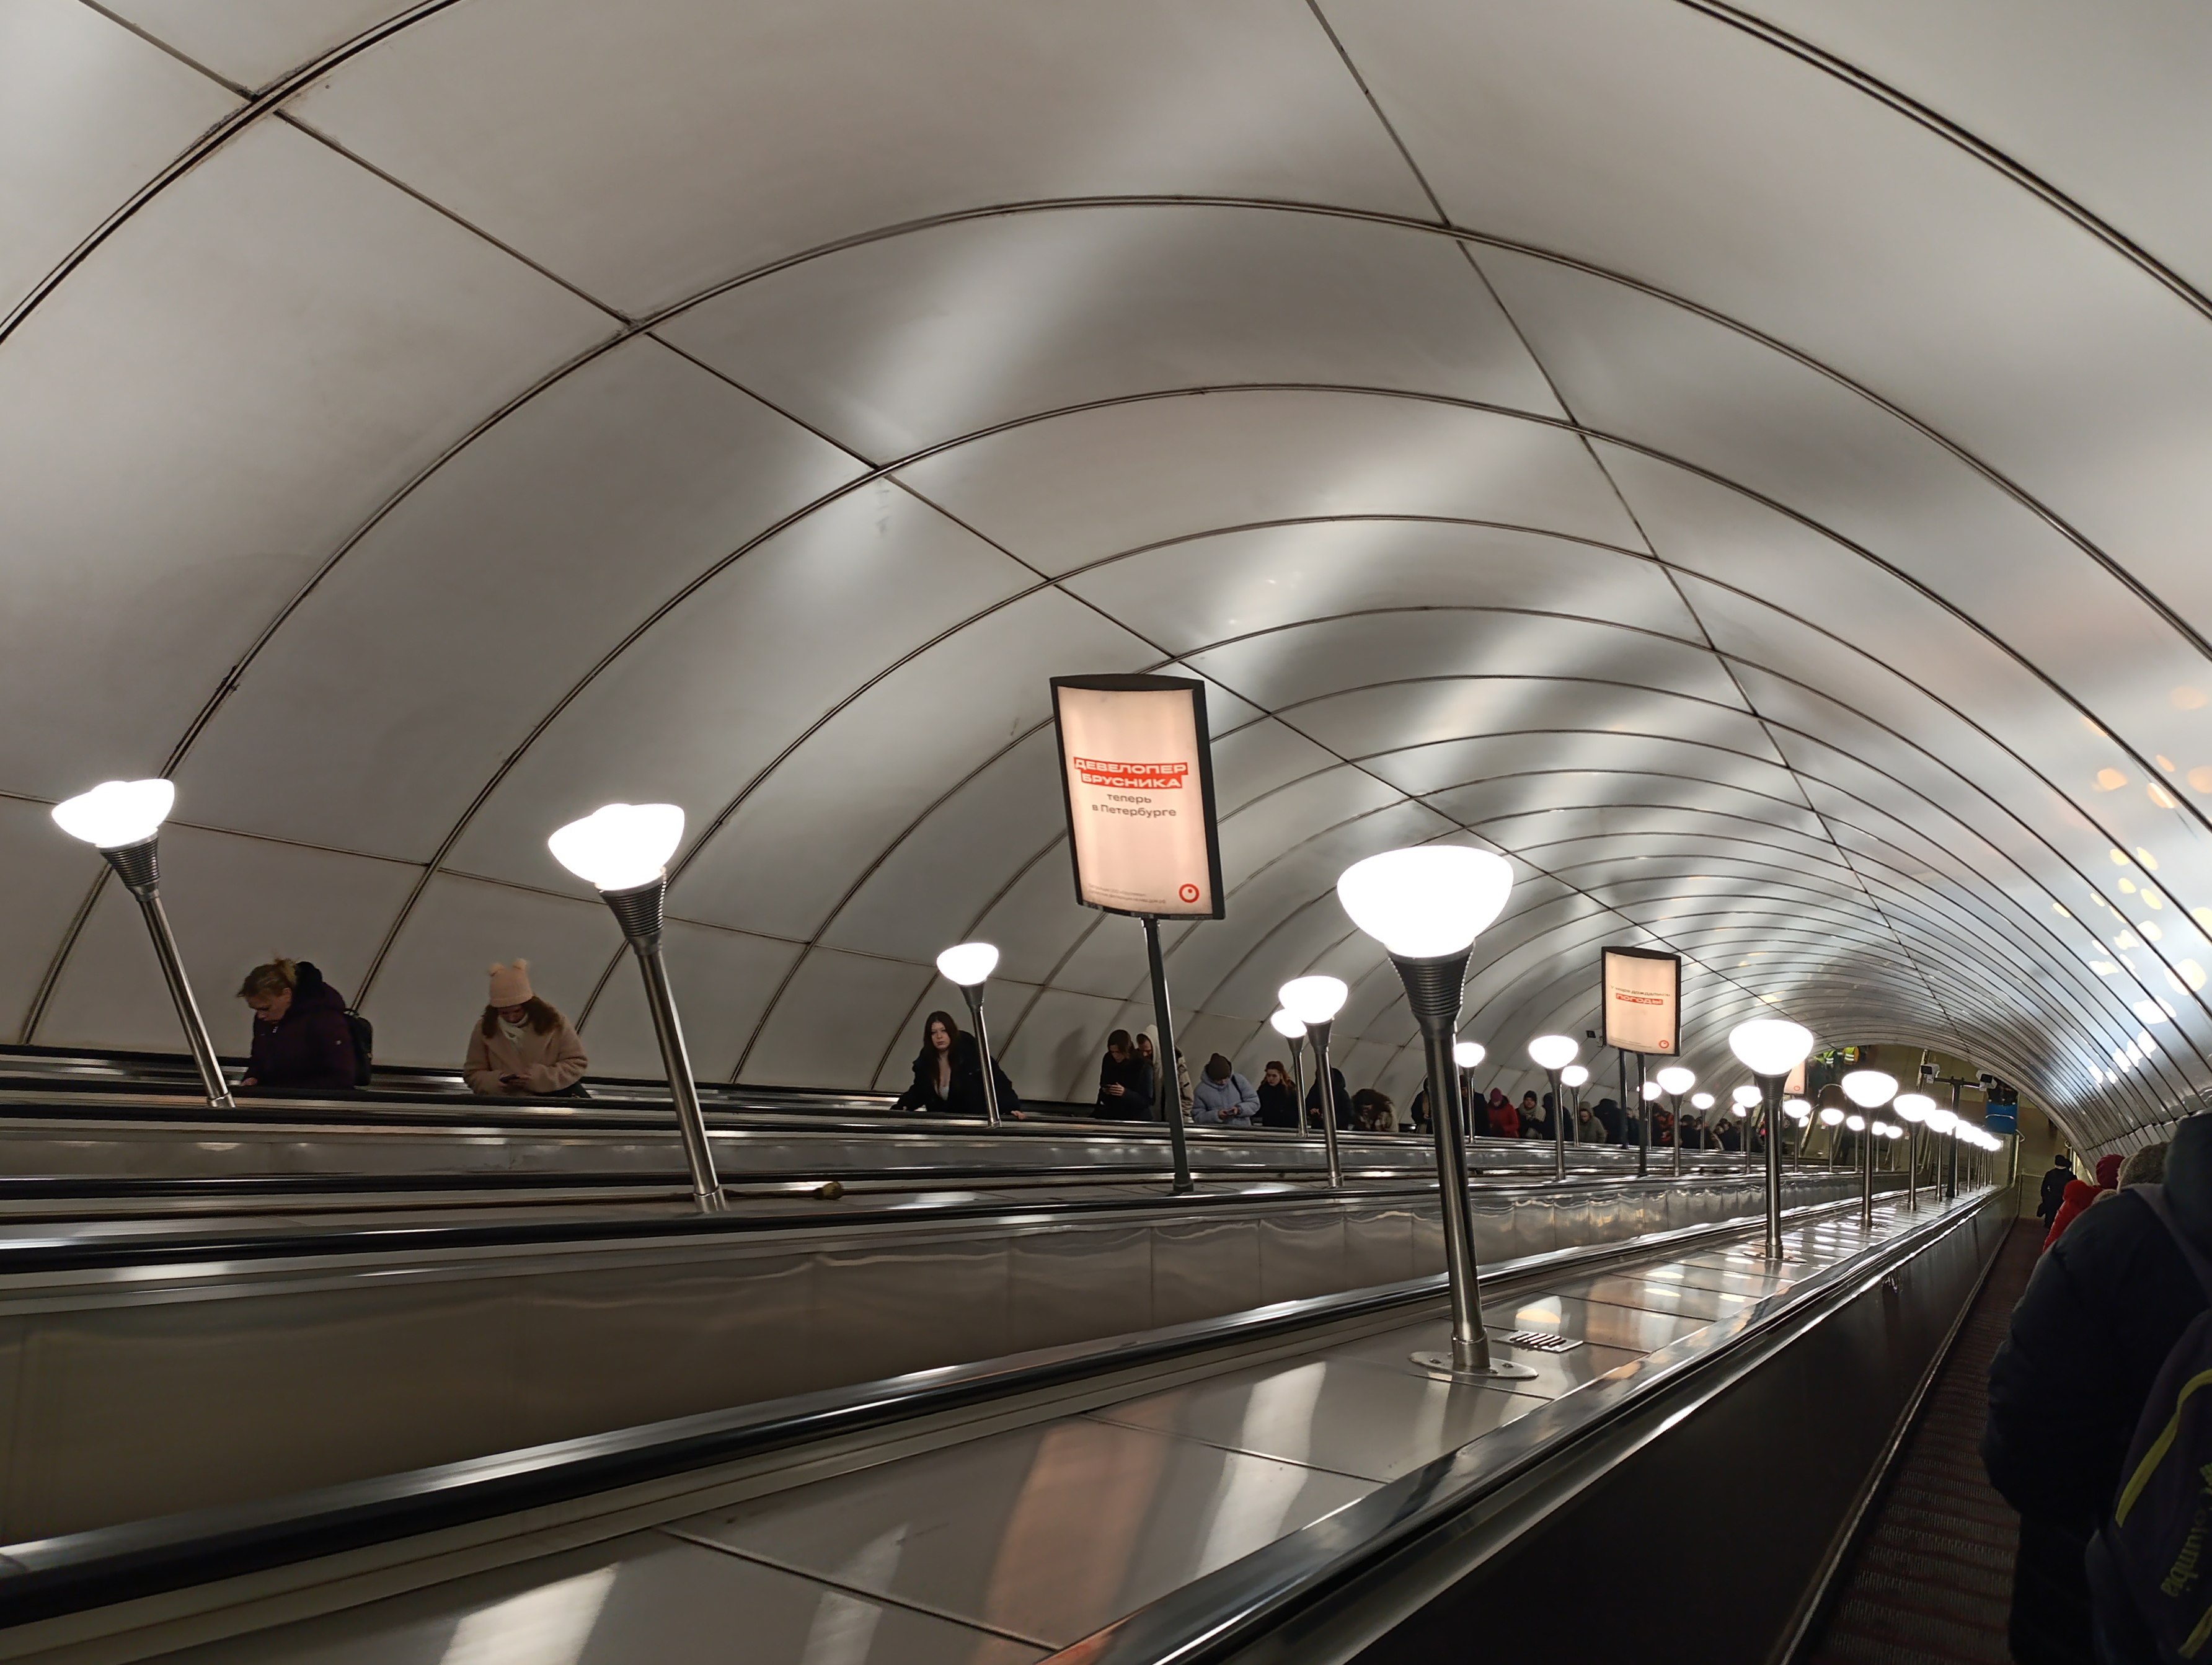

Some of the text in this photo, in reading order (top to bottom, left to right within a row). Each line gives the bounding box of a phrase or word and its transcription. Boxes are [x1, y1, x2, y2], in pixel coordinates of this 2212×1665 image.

[1074, 758, 1187, 775] ДЕВЕЛОПЕР
[1081, 773, 1181, 788] БРУСНИКА
[1107, 793, 1152, 805] теперь
[1100, 805, 1177, 818] Петербурге
